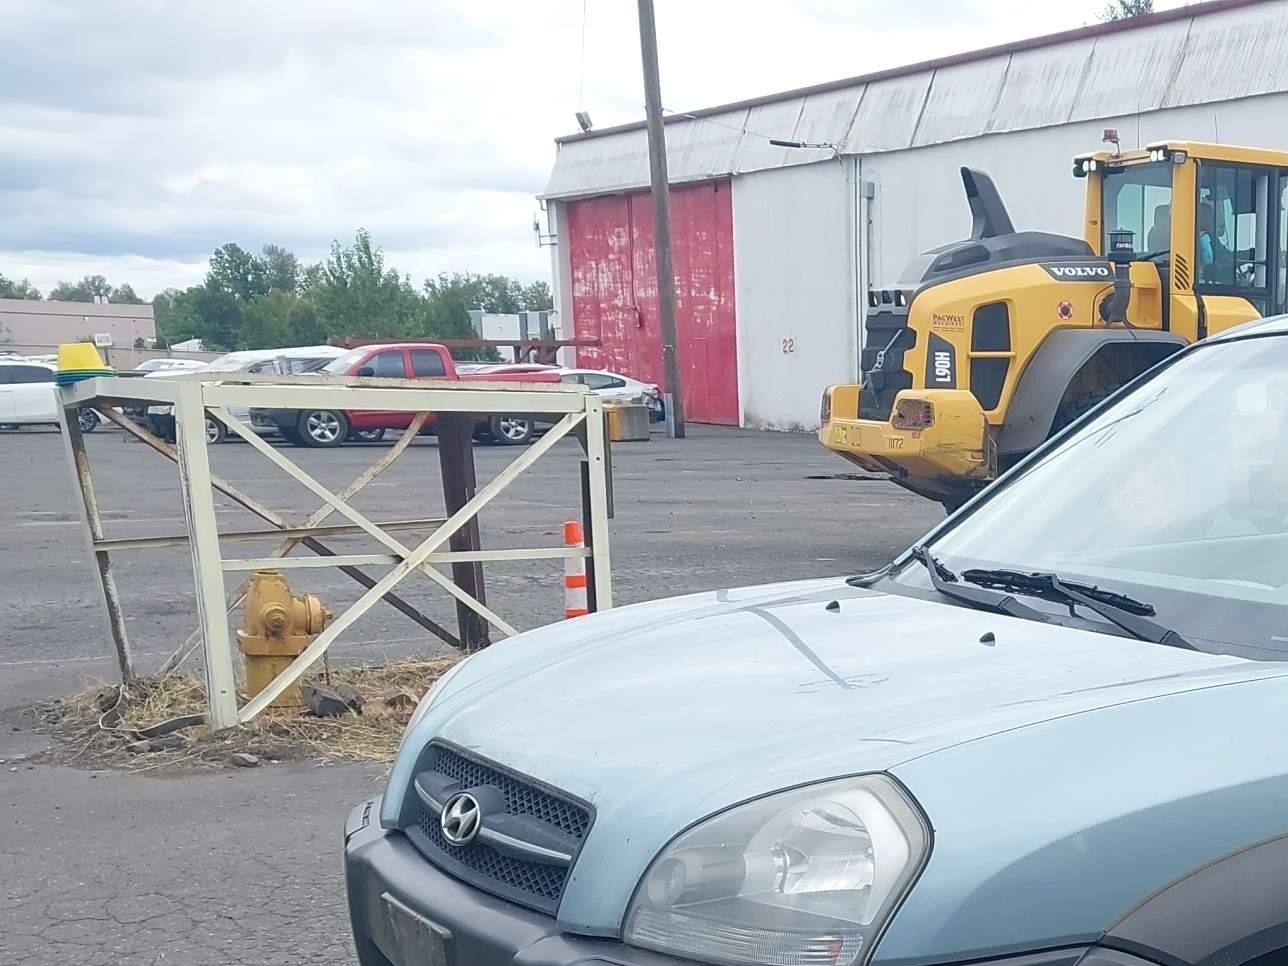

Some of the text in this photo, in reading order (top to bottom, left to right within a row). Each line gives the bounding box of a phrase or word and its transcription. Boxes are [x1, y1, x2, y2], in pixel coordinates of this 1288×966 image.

[1050, 267, 1109, 276] VOLVO
[782, 338, 794, 353] 22
[934, 351, 951, 382] L90H
